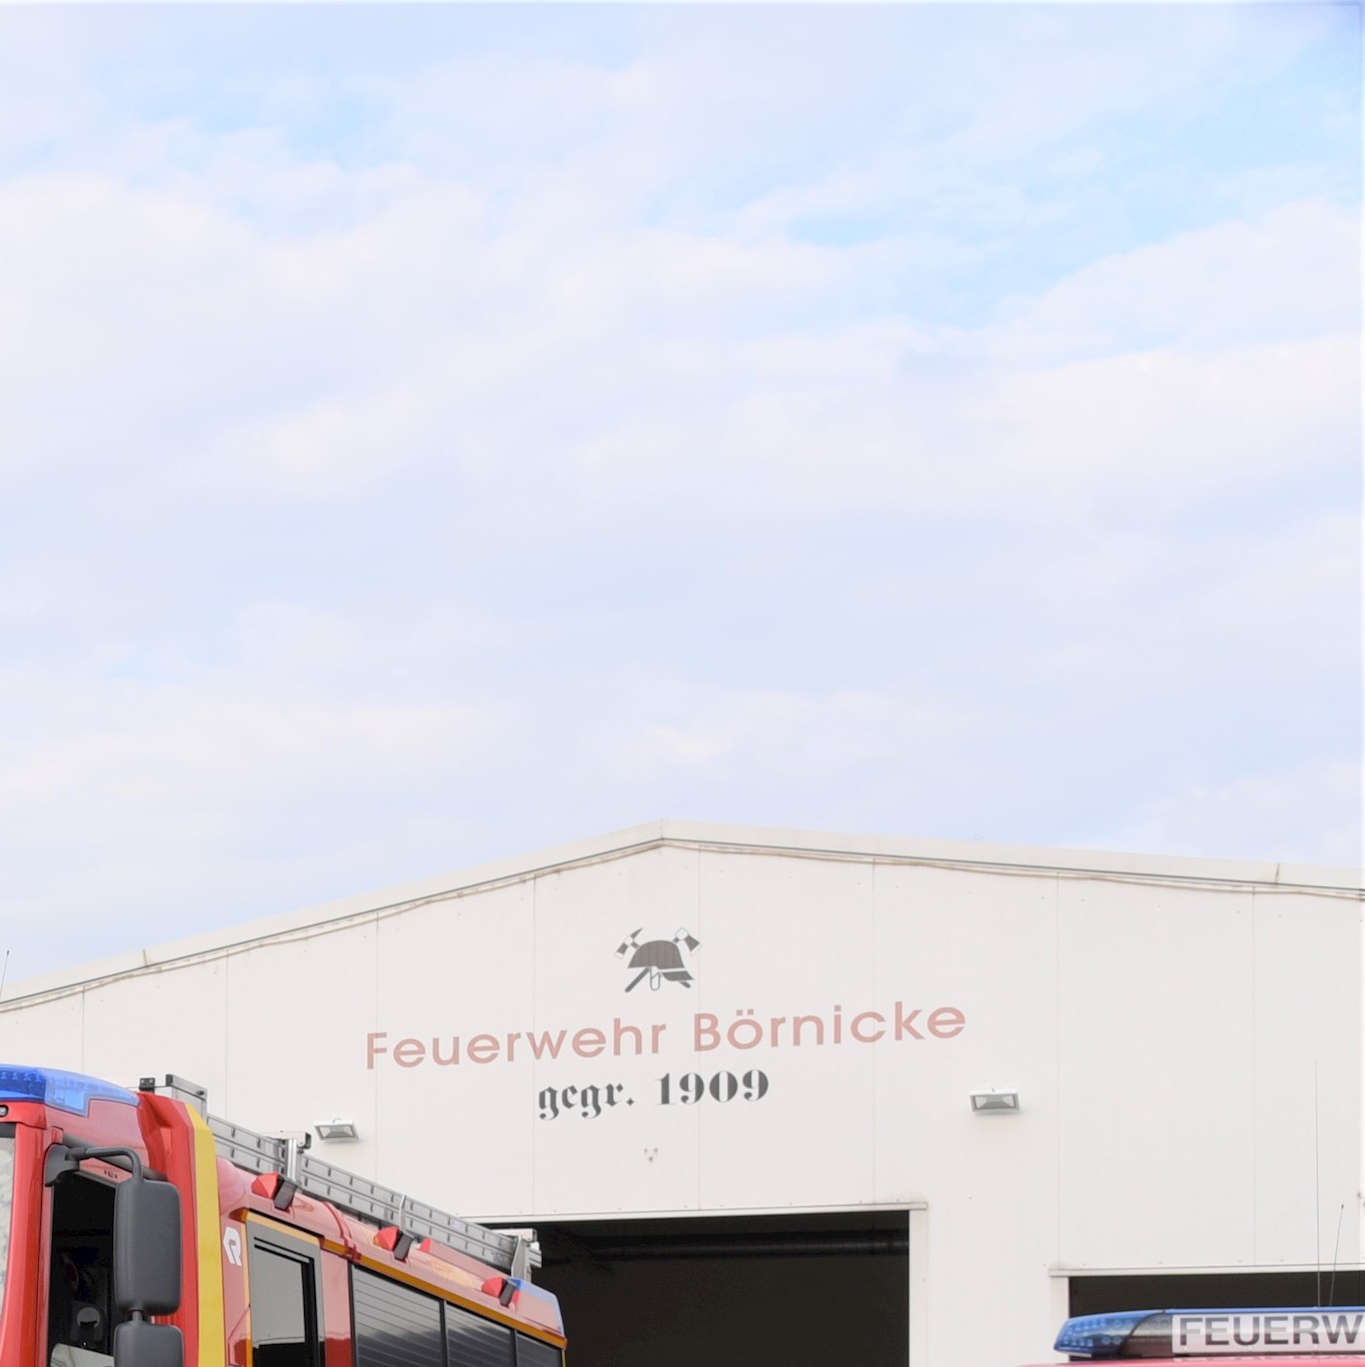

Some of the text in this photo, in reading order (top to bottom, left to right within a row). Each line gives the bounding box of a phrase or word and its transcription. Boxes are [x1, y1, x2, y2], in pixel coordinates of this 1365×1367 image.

[367, 1001, 966, 1070] Feuerwehr Börnicke
[538, 1069, 769, 1121] gegr. 1909
